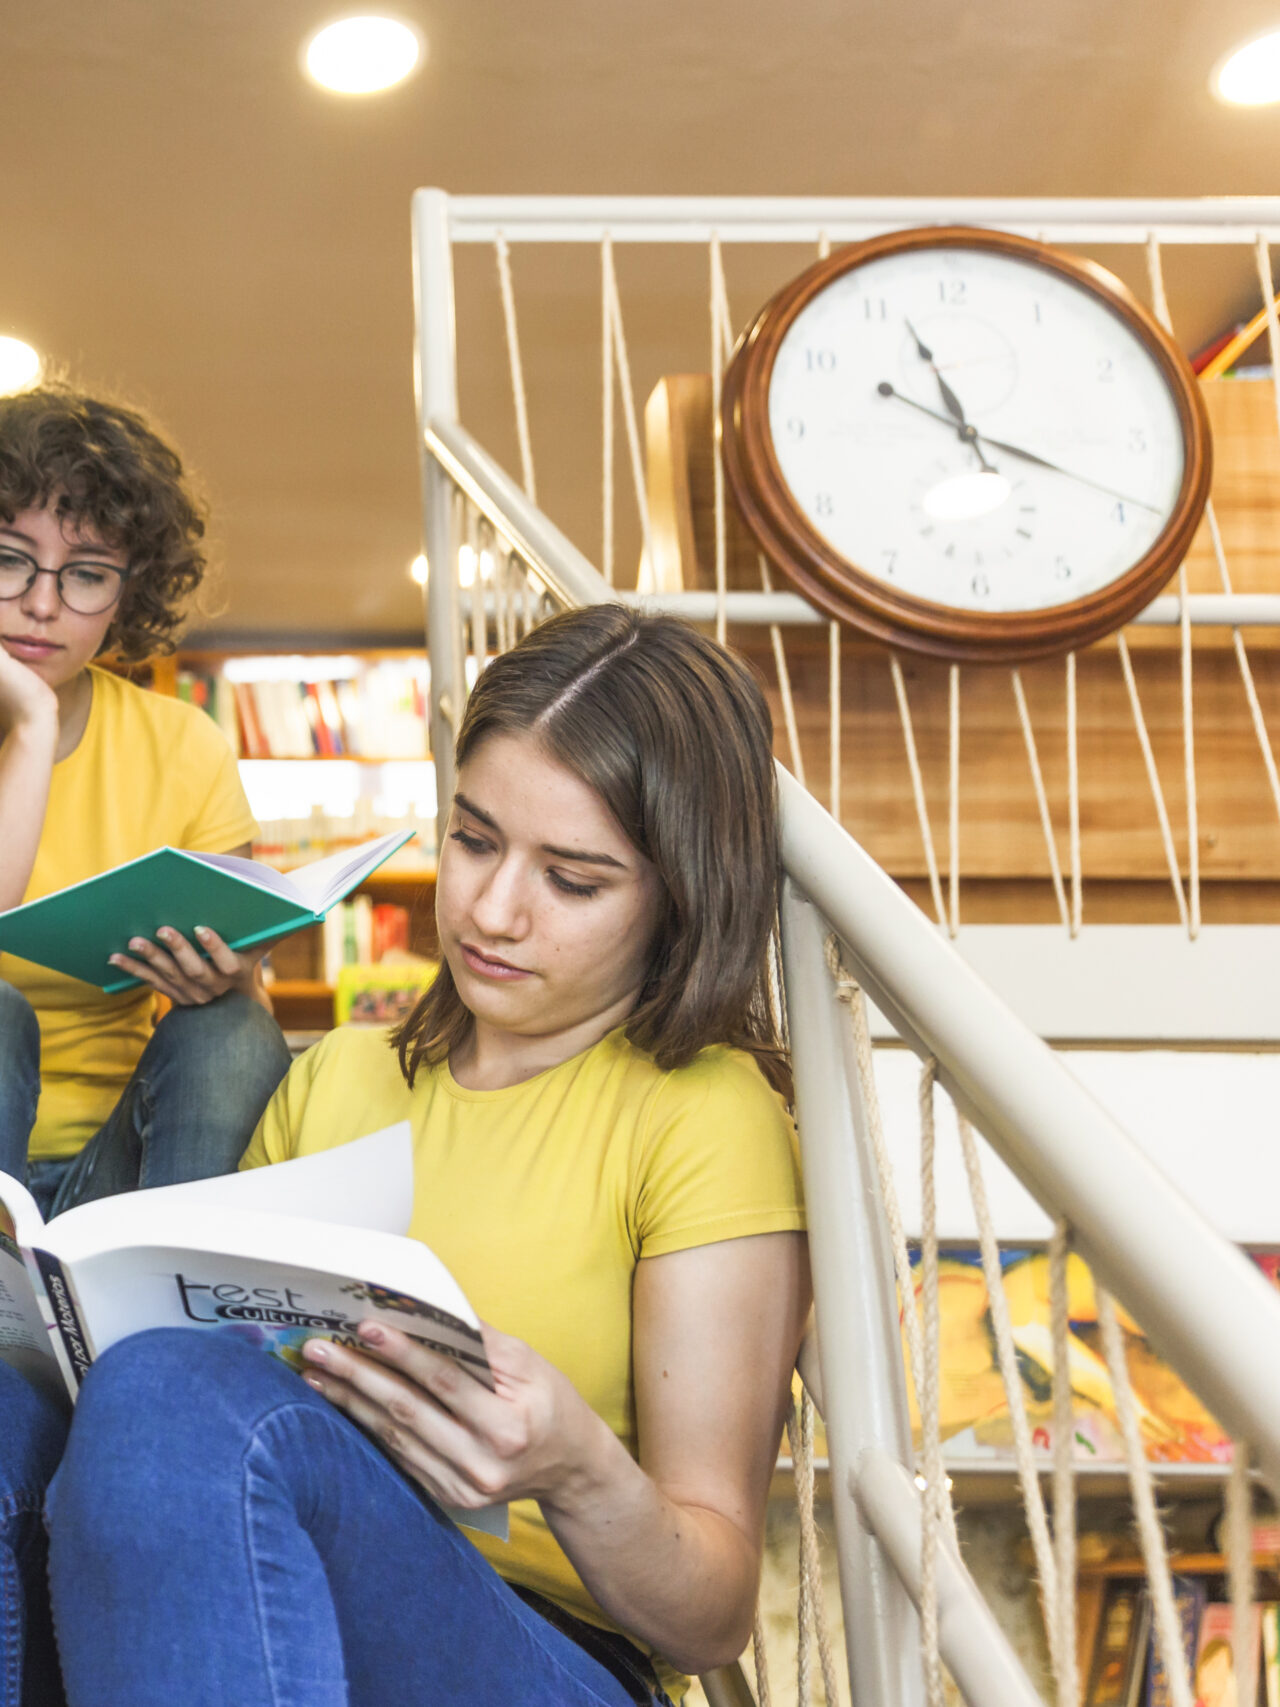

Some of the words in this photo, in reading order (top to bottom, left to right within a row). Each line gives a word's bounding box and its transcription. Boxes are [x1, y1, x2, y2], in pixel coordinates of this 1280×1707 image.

[937, 280, 966, 302] 12
[863, 298, 888, 321] 11
[1033, 302, 1041, 324] 1
[805, 349, 836, 372] 10
[1097, 360, 1115, 383] 2
[788, 418, 805, 440] 9
[1129, 430, 1146, 454] 3
[816, 496, 833, 517] 8
[1109, 503, 1126, 524] 4
[882, 551, 898, 575] 7
[1056, 557, 1071, 580] 5
[972, 575, 989, 598] 6
[175, 1273, 307, 1323] test
